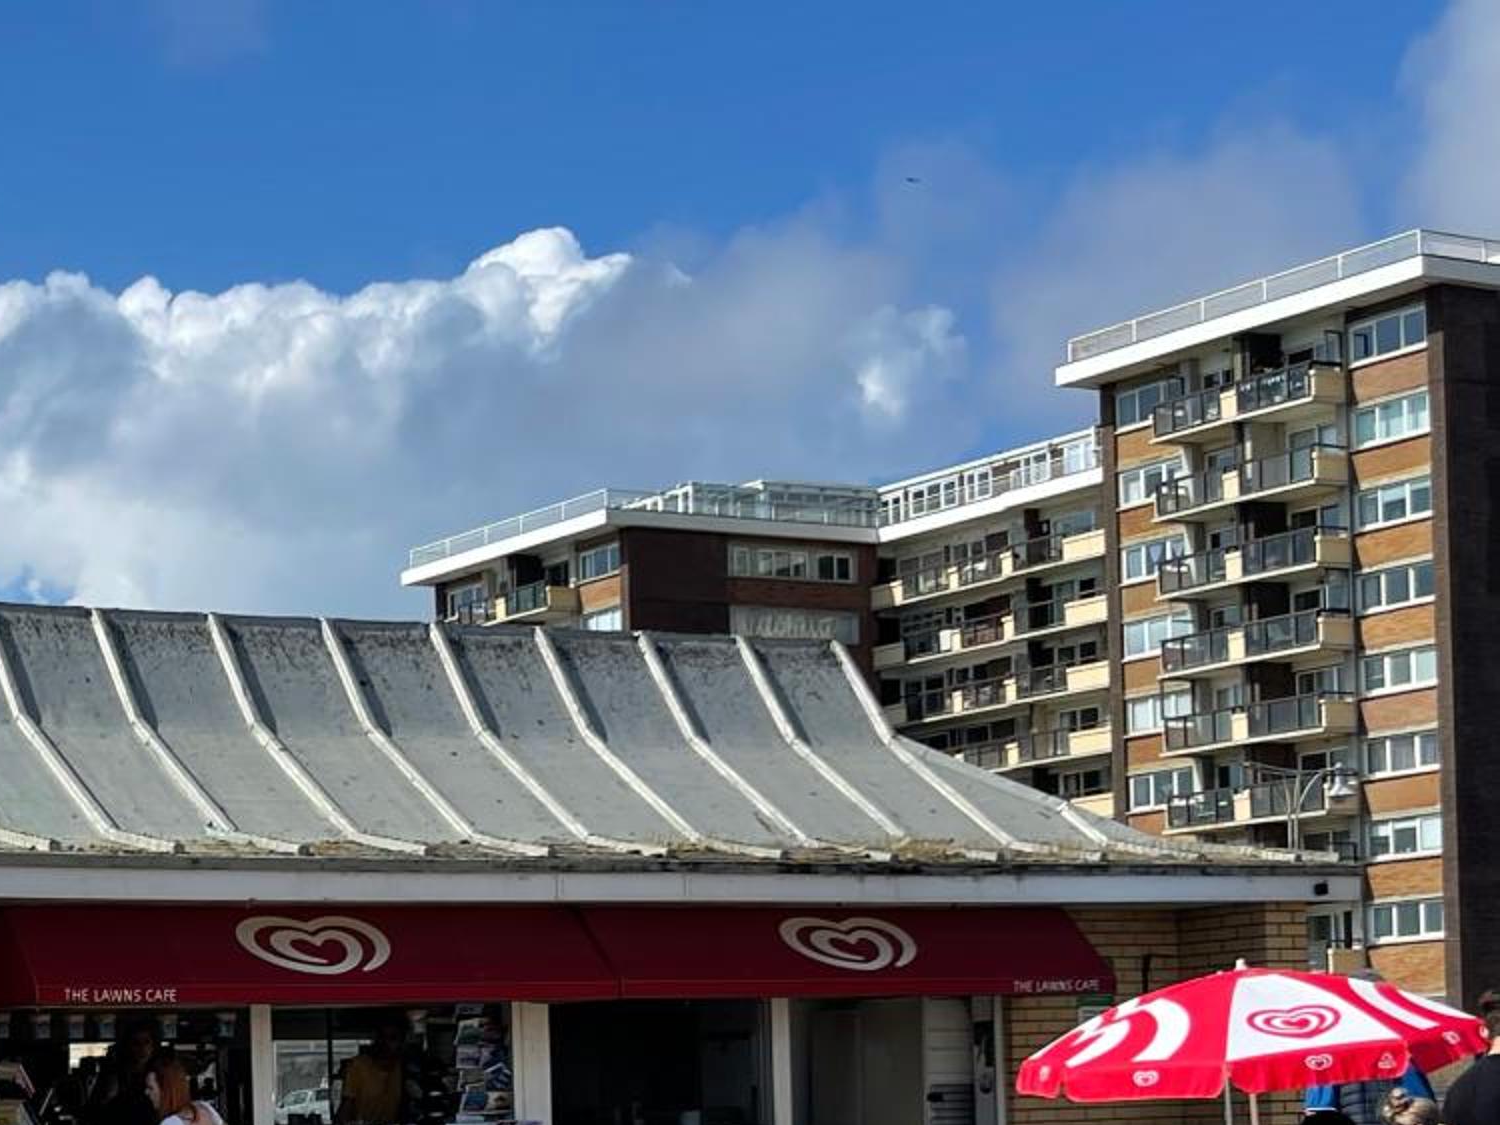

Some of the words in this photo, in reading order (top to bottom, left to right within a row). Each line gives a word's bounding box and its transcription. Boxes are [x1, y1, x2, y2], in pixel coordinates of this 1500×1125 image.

[1013, 980, 1033, 993] THE
[1035, 980, 1073, 993] LAWNS
[1075, 979, 1100, 992] CAFE
[64, 988, 89, 1002] THE
[93, 988, 142, 1003] LAWNS
[145, 988, 178, 1003] CAFE
